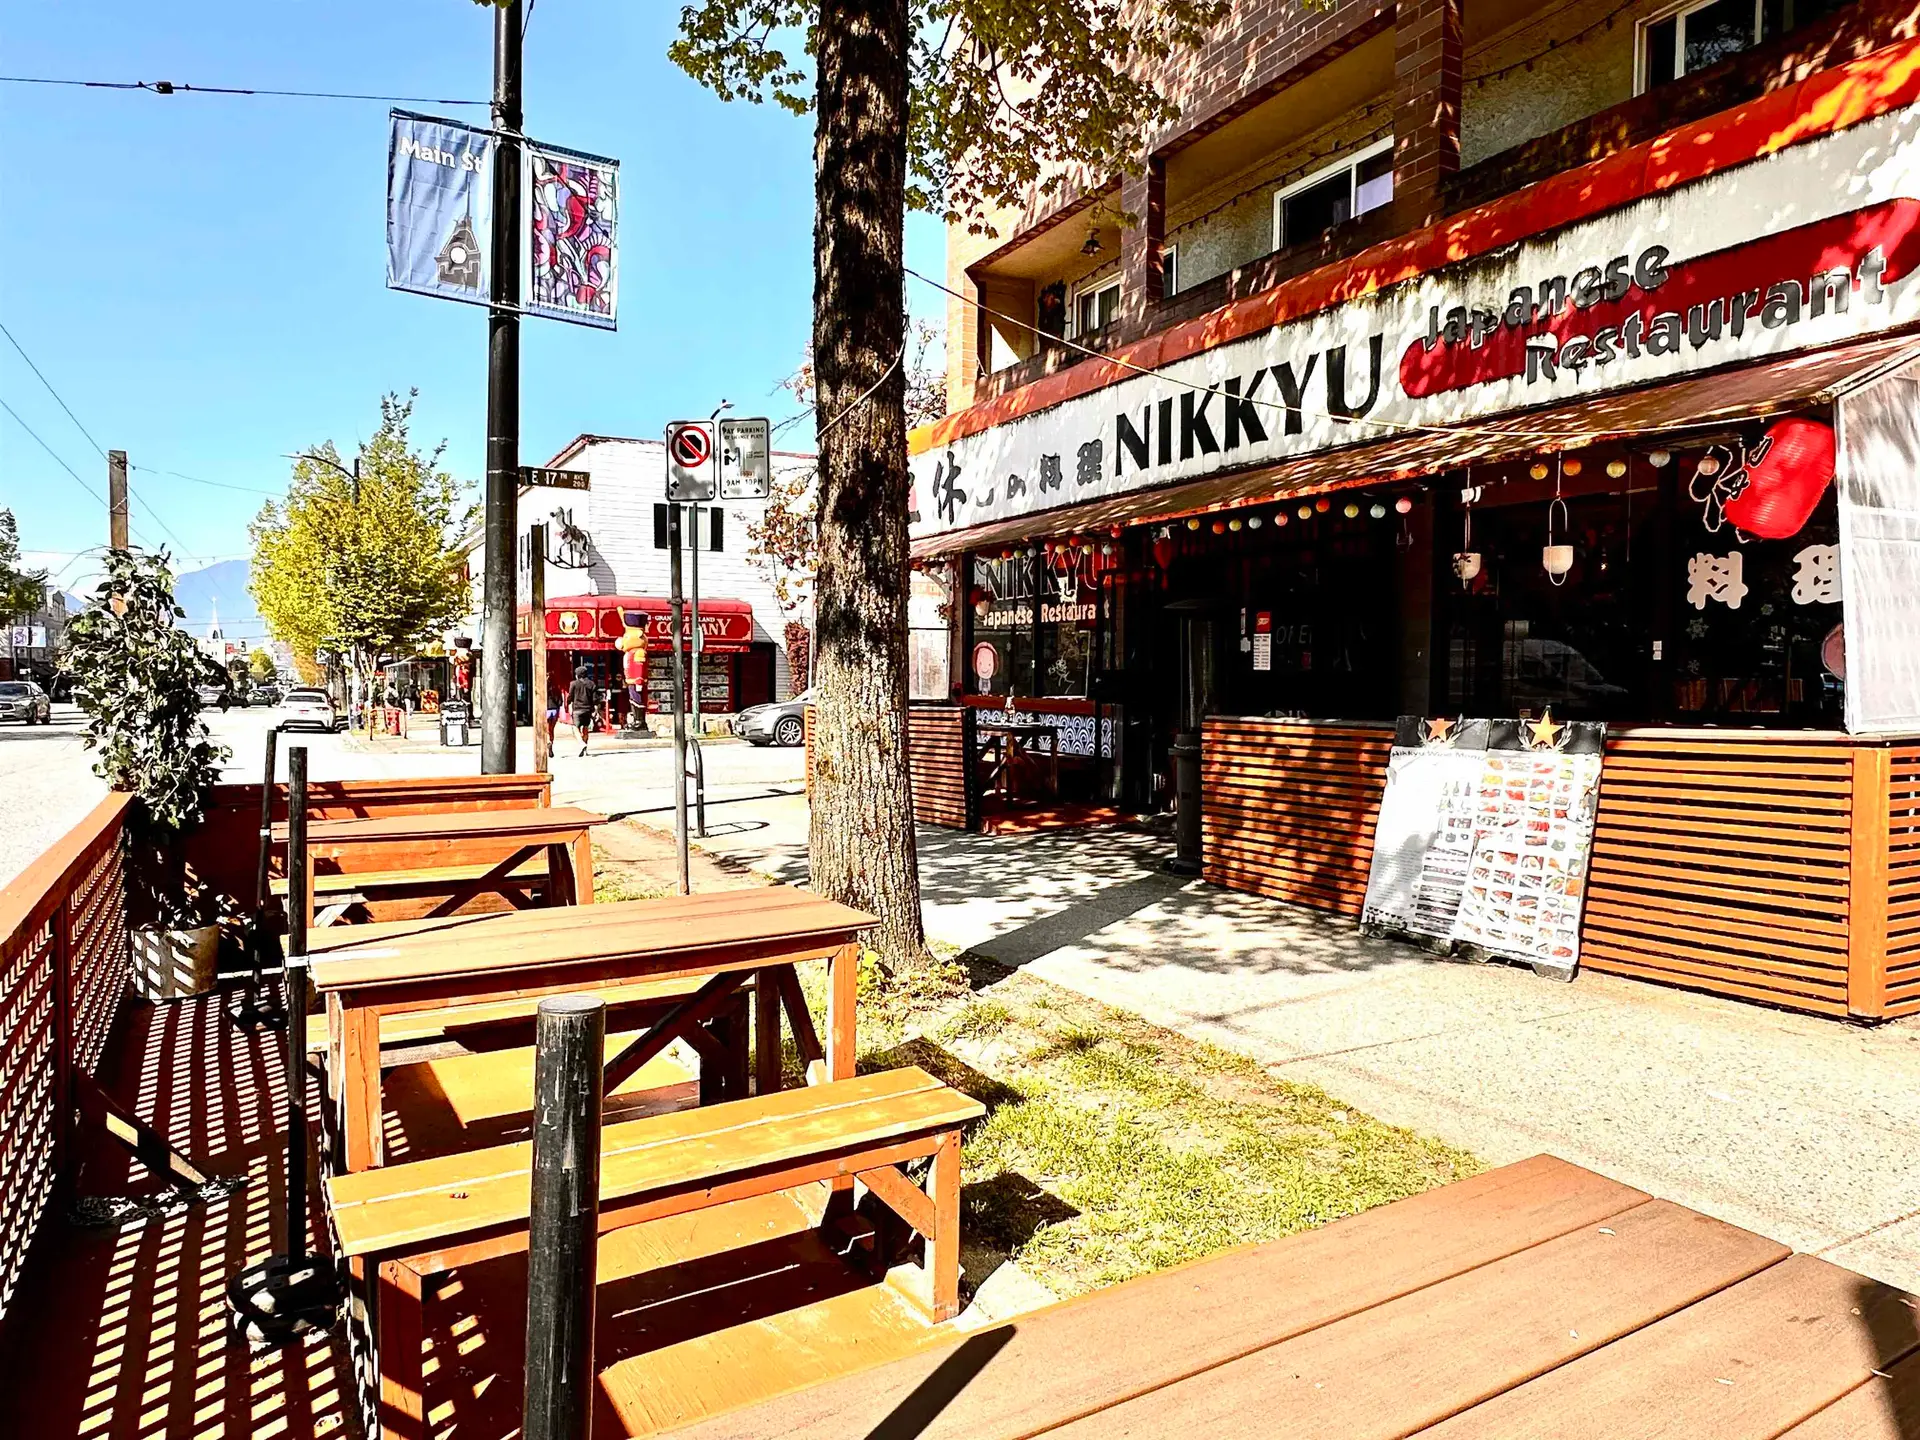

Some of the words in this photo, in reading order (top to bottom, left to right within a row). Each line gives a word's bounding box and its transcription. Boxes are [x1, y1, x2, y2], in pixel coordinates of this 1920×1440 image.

[400, 137, 456, 169] Main
[461, 153, 484, 174] St
[1424, 245, 1670, 352] Japanese
[1526, 244, 1886, 385] Restaurant
[1116, 333, 1384, 477] NIKKYU
[723, 426, 734, 434] PAY
[531, 470, 539, 484] E
[983, 543, 1109, 601] NIKKYU
[983, 608, 1034, 630] Japanese
[1041, 600, 1110, 623] Restaurat
